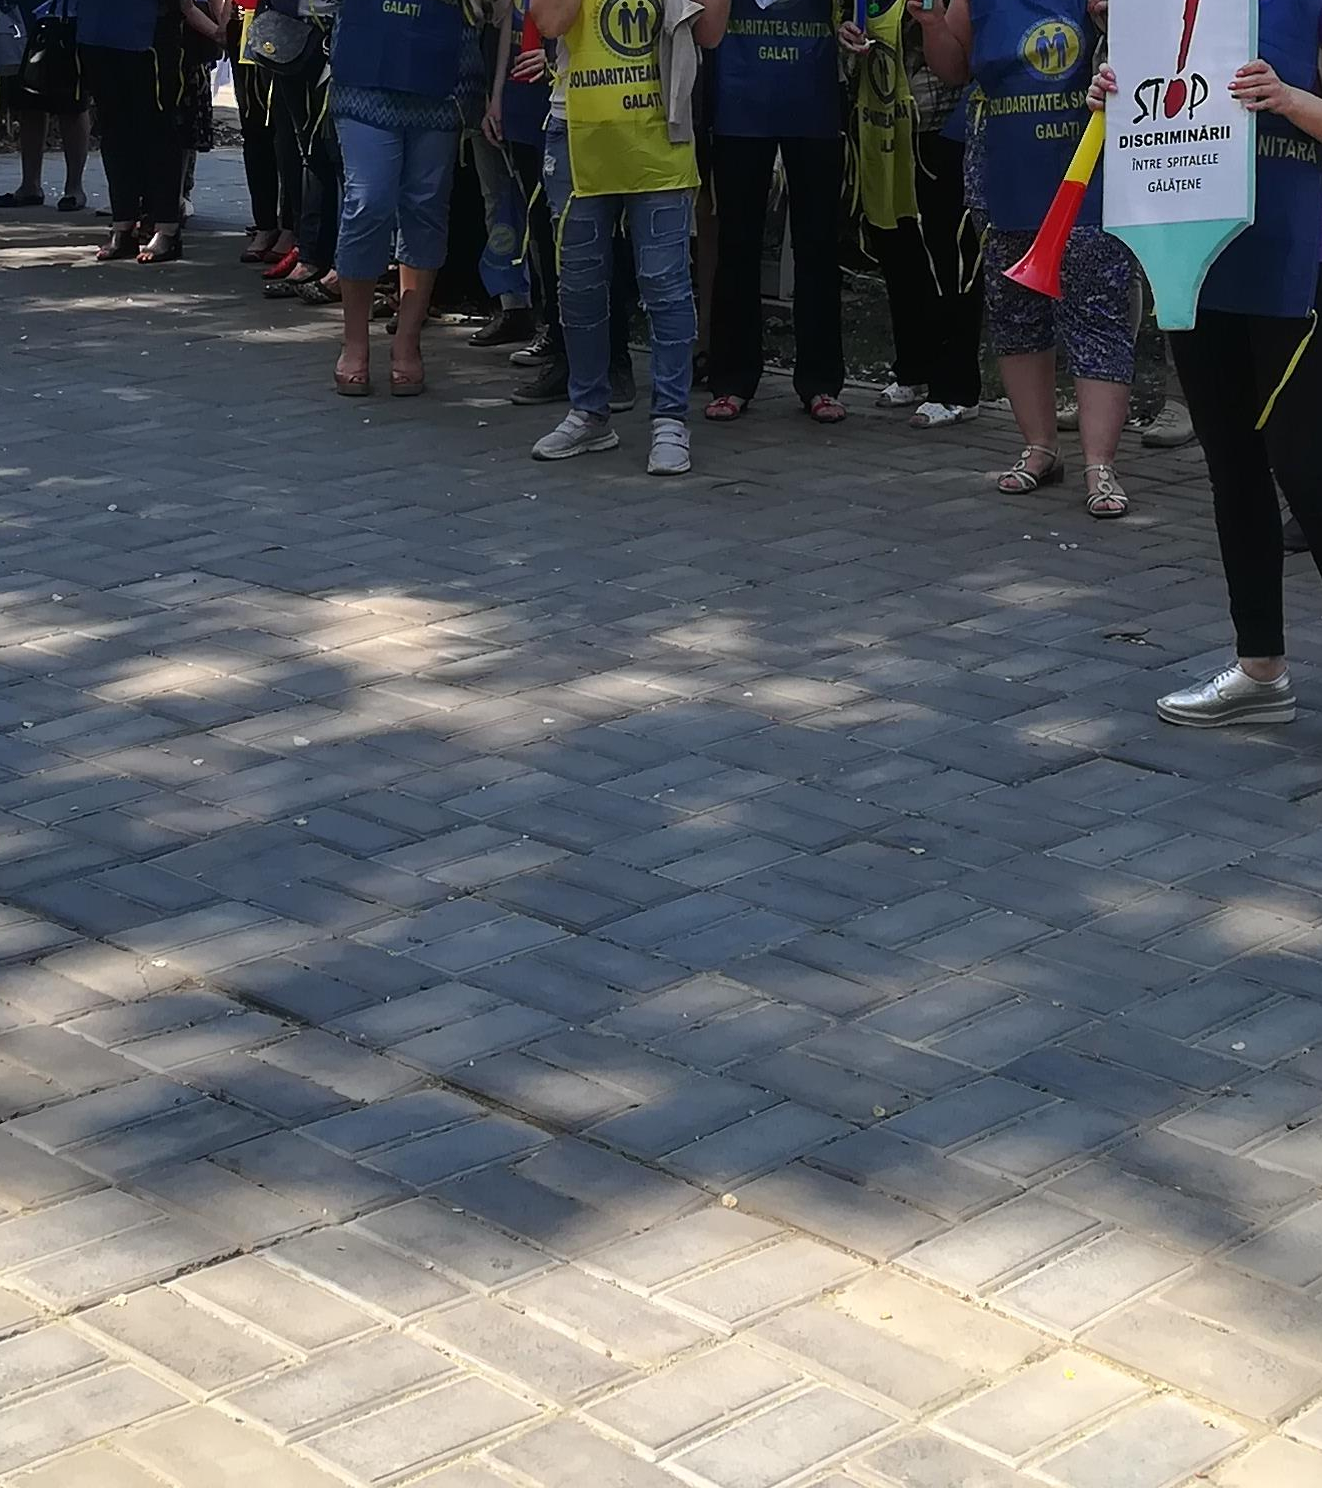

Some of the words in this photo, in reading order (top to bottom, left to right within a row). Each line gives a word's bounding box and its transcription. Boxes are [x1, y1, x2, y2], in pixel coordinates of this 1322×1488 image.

[1132, 72, 1210, 124] STOP
[1119, 125, 1231, 149] DISCRIMINĂRII
[1132, 157, 1163, 172] ÎNTRE
[1167, 153, 1219, 168] SPITALELE
[1148, 177, 1202, 193] GĂLĂȚENE
